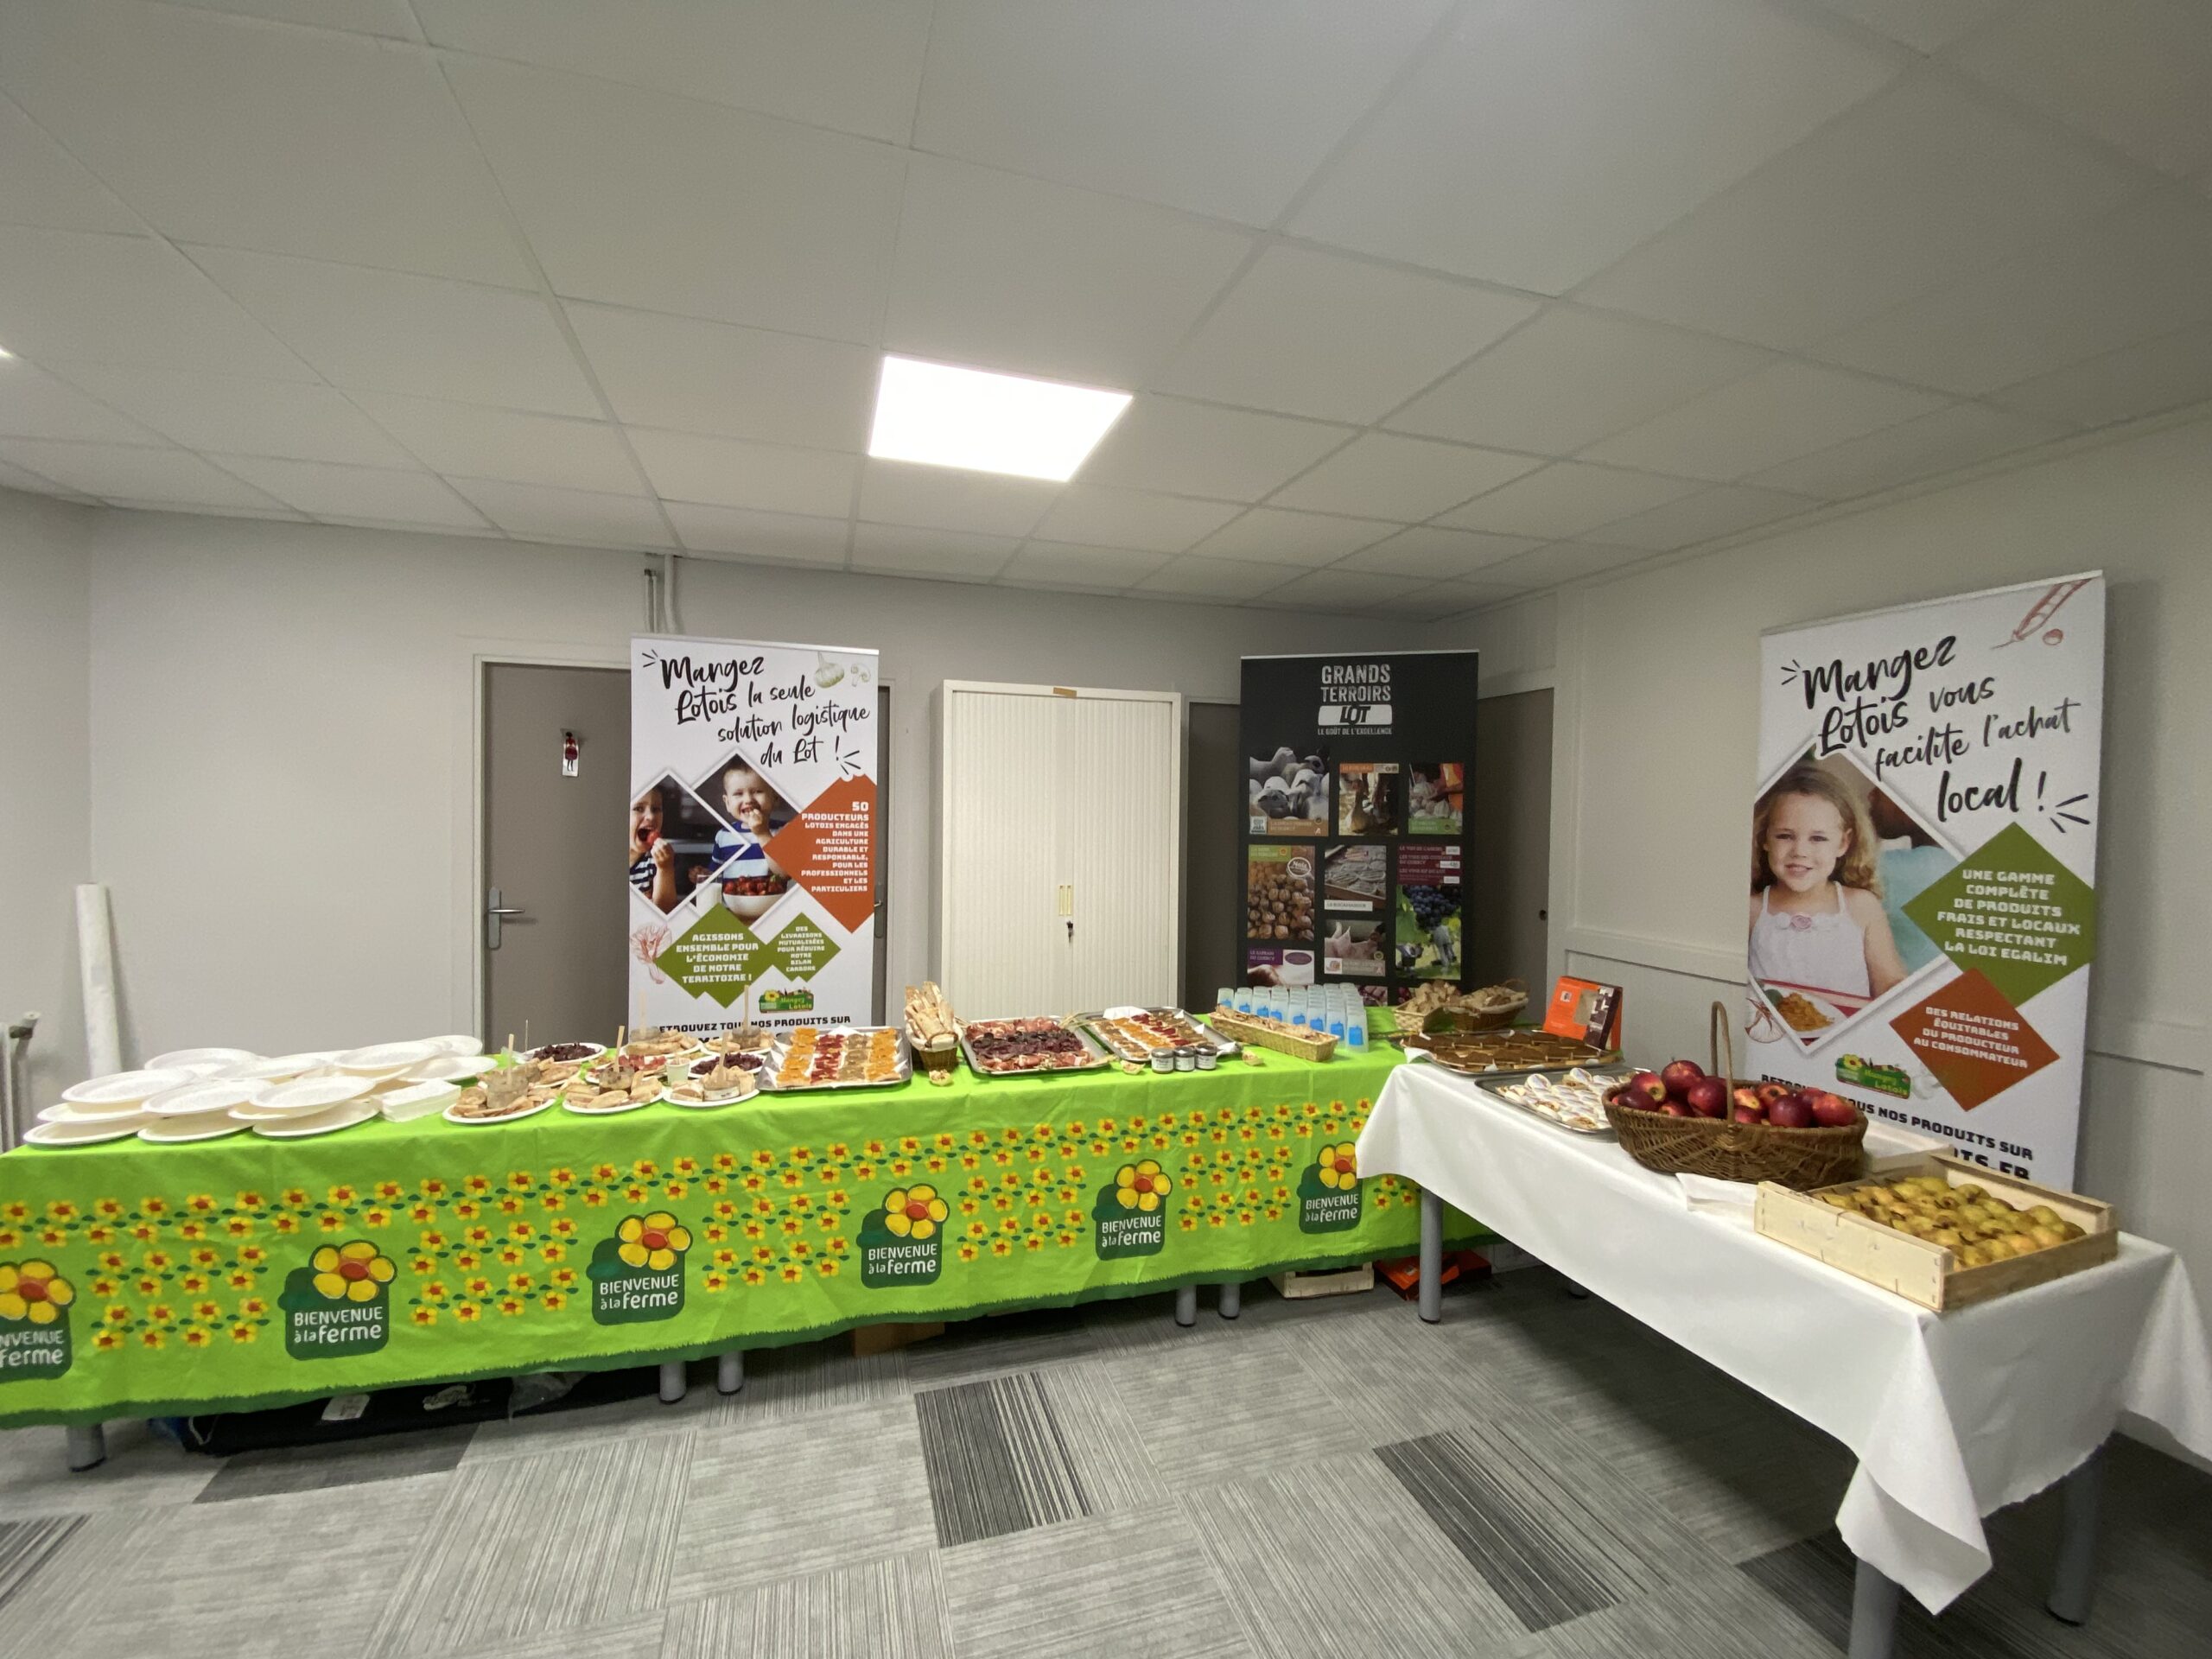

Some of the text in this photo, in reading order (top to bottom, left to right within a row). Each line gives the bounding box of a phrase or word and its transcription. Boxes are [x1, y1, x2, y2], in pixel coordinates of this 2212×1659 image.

[660, 656, 764, 691] Mangez
[1321, 664, 1391, 684] GRANDS
[1802, 636, 1956, 709] Mangez
[675, 675, 815, 725] Lotois la seule
[1320, 685, 1391, 702] TERROIRS
[718, 700, 870, 743] solution logistique
[1339, 704, 1371, 725] LOT
[1817, 677, 1996, 756] Lotois vous
[1876, 697, 2081, 782] facilite l'achat
[761, 742, 782, 767] du
[793, 736, 824, 764] Lot
[1937, 758, 2047, 823] local !
[852, 802, 868, 811] 50
[1962, 869, 2055, 885] UNE GAMME
[1966, 884, 2049, 900] COMPLÈTE
[1954, 899, 2063, 918] DE PRODUITS
[1937, 912, 2081, 935] FRAIS ET LOCAUX
[677, 944, 730, 952] ENSEMBLE
[692, 933, 744, 942] AGISSONS
[1955, 928, 2056, 948] RESPECTANT
[686, 953, 748, 963] L'ÉCONOMIE
[1945, 941, 2068, 966] LA LOI EGALIM
[682, 974, 747, 983] TERRITOIRE
[659, 1022, 717, 1033] ETROUVEZ
[774, 1017, 829, 1027] PRODUITS
[1925, 1007, 2018, 1031] DES RELATIONS
[1934, 1018, 2009, 1041] ÉQUITABLES
[1923, 1028, 2019, 1055] DU PRODUCTEUR
[1914, 1037, 2028, 1068] AU CONSOMMATEUR
[1847, 1098, 2033, 1160] OUS NOS PRODUITS SUR
[1306, 1193, 1358, 1211] BIENVENUE
[1102, 1215, 1162, 1234] BIENVENUE
[1319, 1206, 1358, 1223] ferme
[1117, 1229, 1161, 1246] ferme
[868, 1243, 938, 1260] BIENVENUE
[887, 1257, 936, 1275] ferme
[600, 1274, 679, 1296] BIENVENUE
[622, 1288, 678, 1310] ferme
[294, 1306, 383, 1327] BIENVENUE
[0, 1330, 64, 1348] NVENUE
[317, 1323, 382, 1345] ferme
